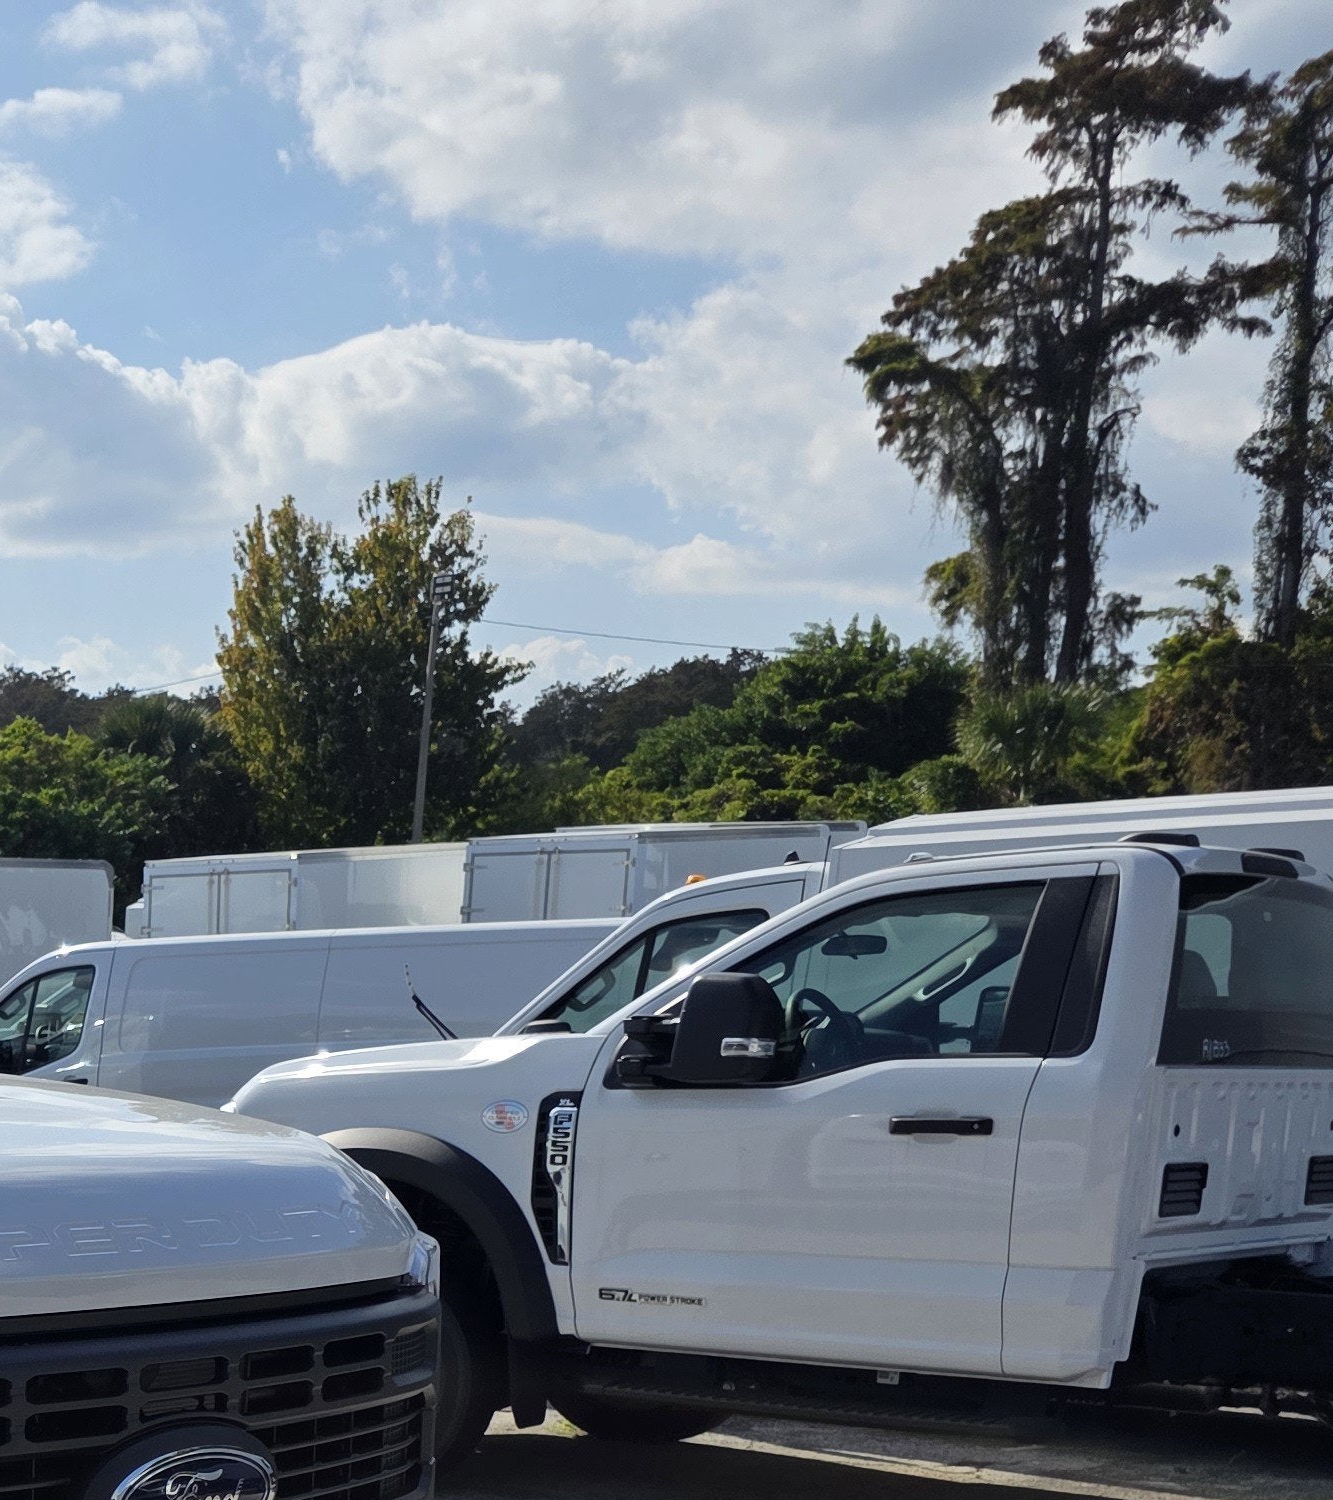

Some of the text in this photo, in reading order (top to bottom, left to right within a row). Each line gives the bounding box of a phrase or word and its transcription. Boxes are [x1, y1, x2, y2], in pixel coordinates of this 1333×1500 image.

[549, 1113, 573, 1166] F550
[638, 1294, 668, 1303] POWER
[669, 1295, 704, 1306] STROKE
